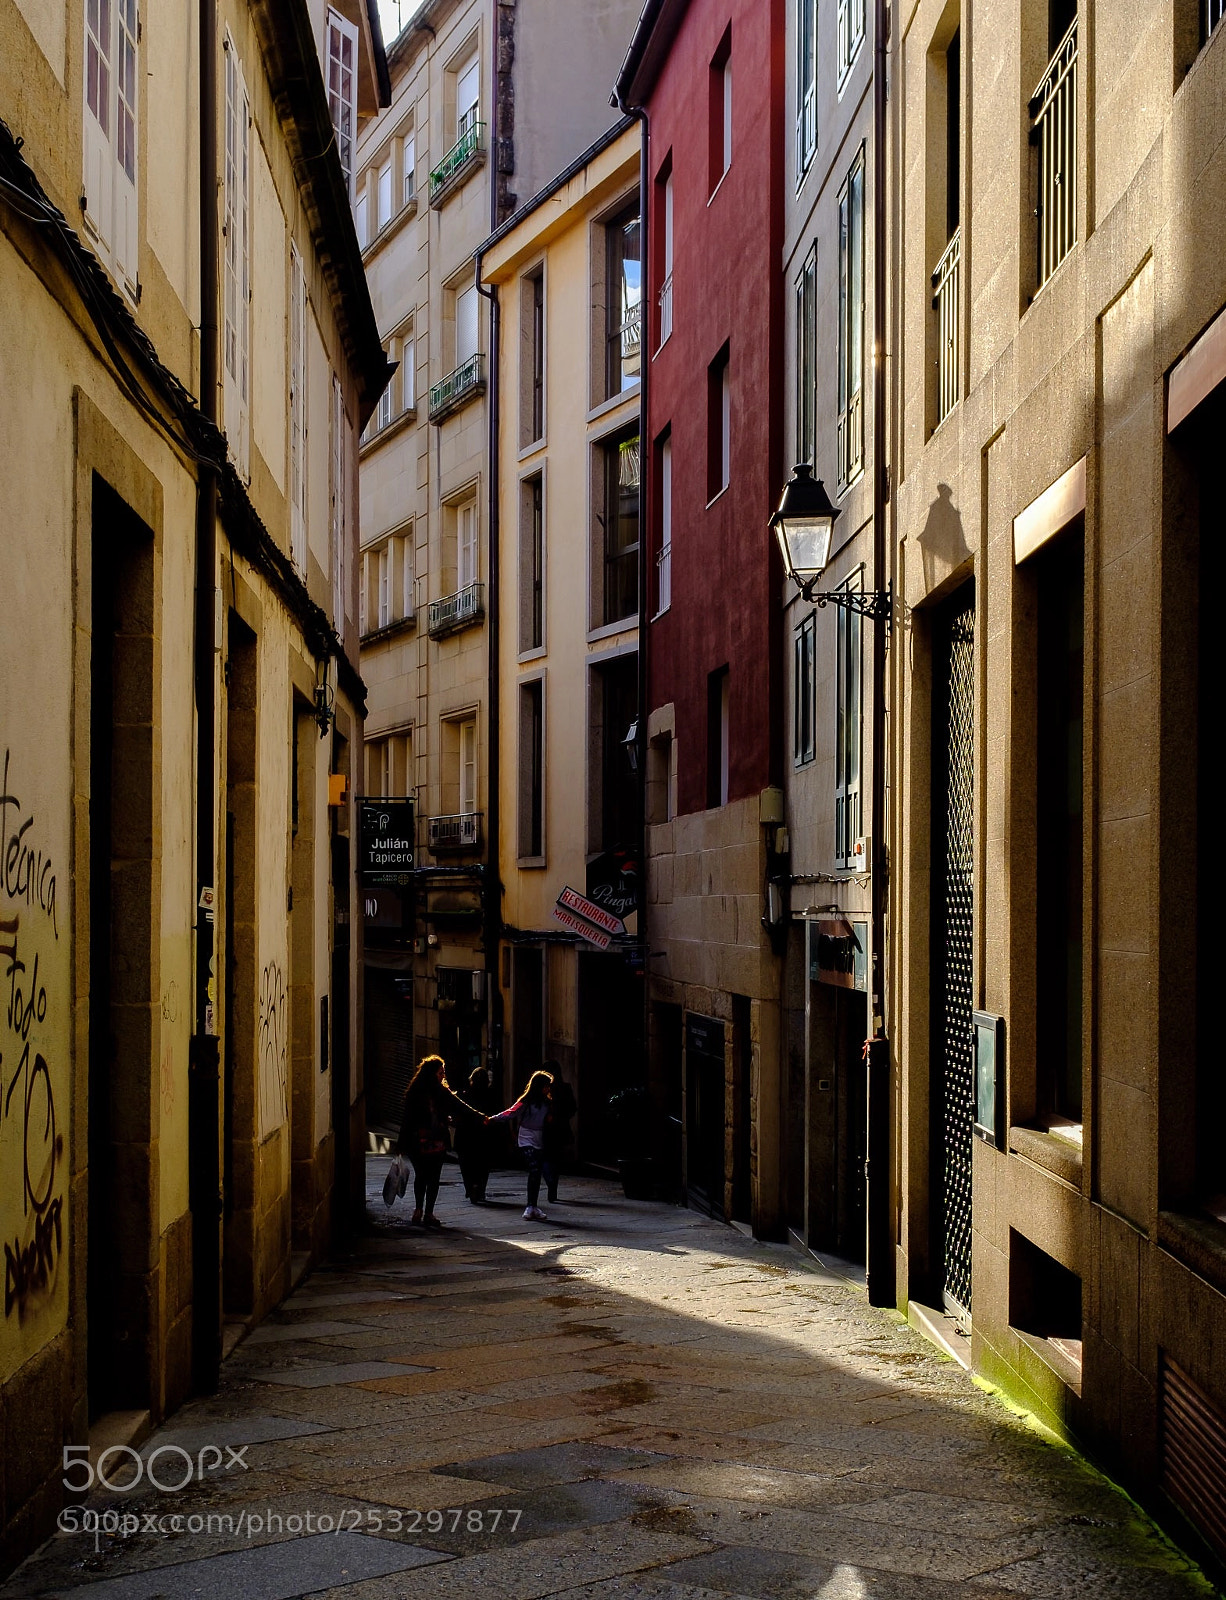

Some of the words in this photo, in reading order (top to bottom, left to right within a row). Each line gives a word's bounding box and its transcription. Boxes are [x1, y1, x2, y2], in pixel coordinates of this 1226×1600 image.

[371, 837, 409, 849] Julián
[368, 851, 413, 865] Tapicero
[561, 890, 620, 932] RESTAURANTE
